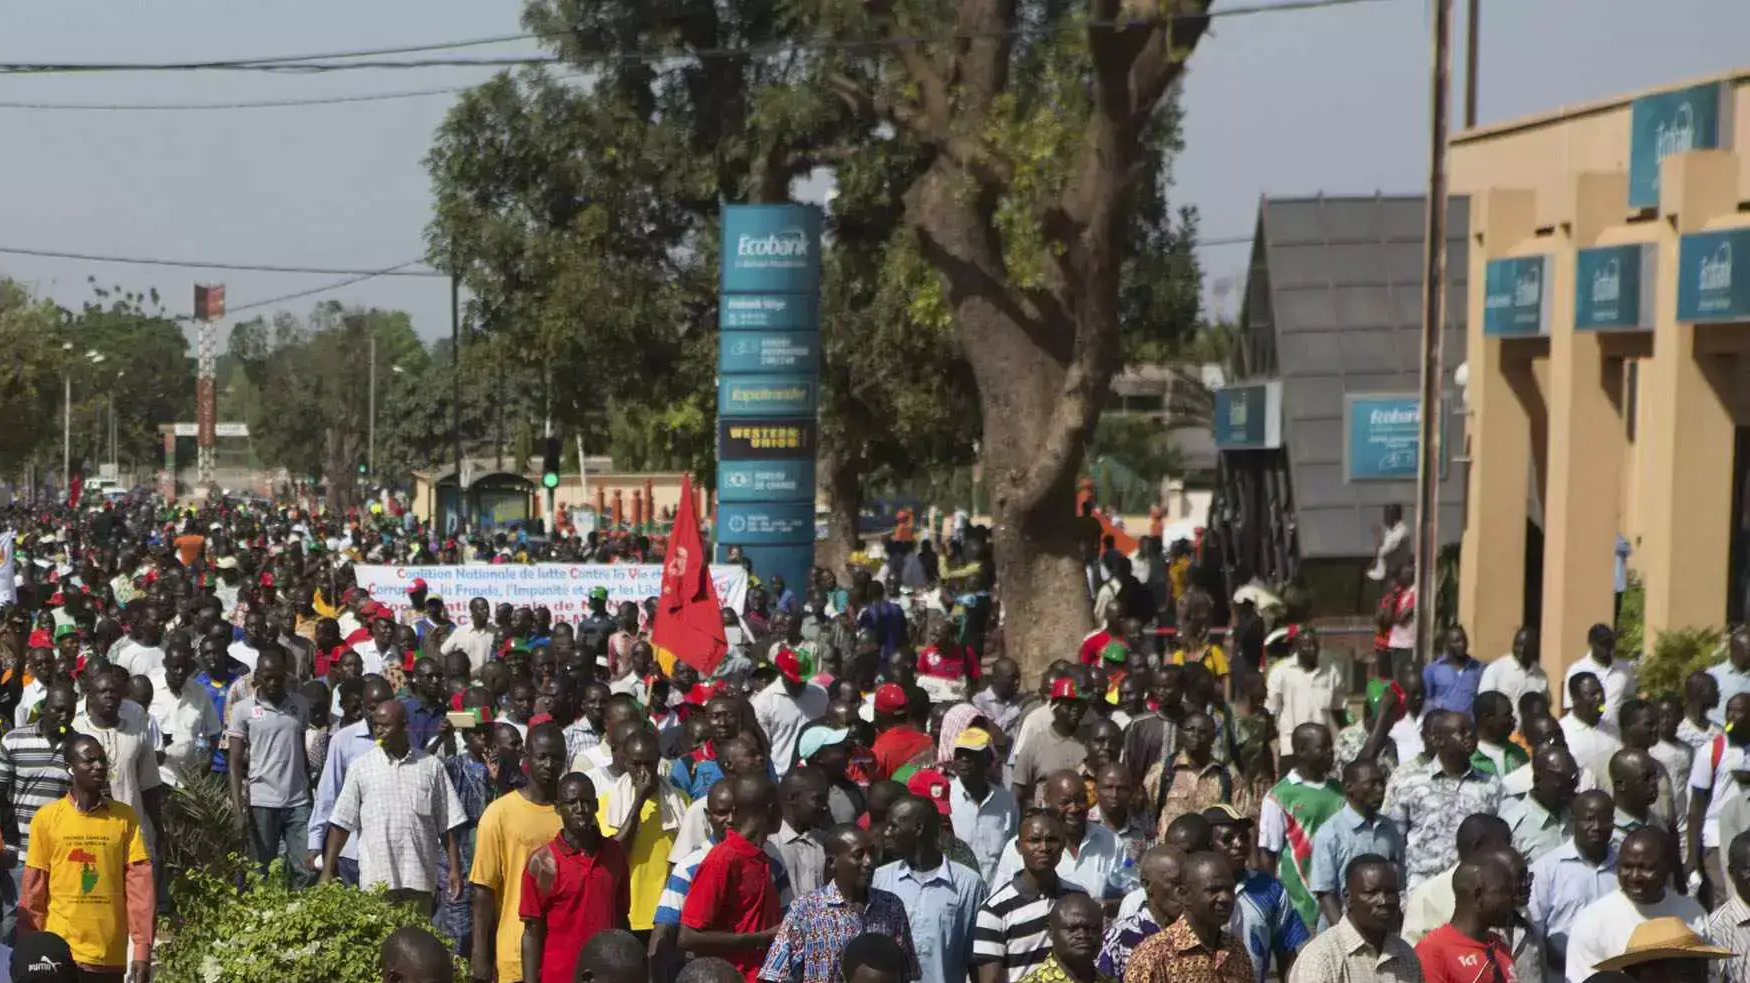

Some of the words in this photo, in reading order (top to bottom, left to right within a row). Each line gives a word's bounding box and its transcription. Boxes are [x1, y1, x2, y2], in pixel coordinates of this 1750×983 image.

[737, 234, 809, 256] Ecobank
[730, 428, 799, 439] WESTERN
[751, 438, 797, 448] UNION
[397, 567, 452, 579] Coalition
[455, 567, 516, 579] Nationale
[520, 568, 534, 579] de
[538, 568, 567, 578] lutte
[570, 567, 610, 579] Contre
[553, 600, 574, 611] de
